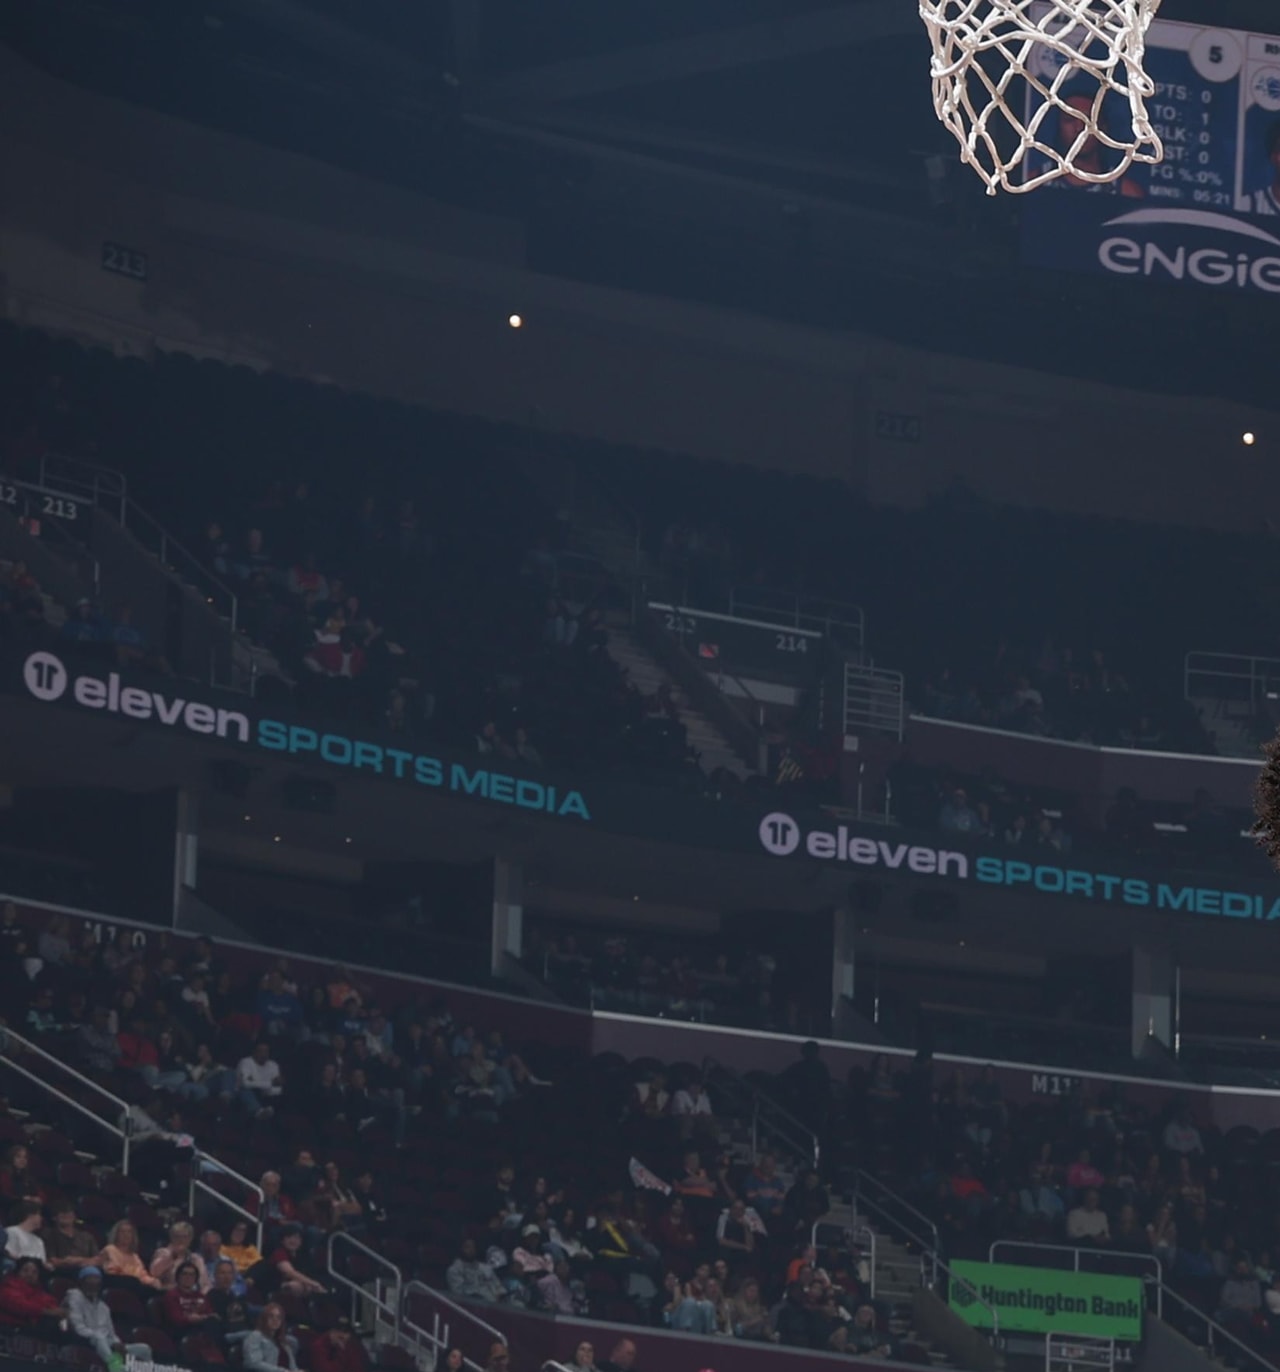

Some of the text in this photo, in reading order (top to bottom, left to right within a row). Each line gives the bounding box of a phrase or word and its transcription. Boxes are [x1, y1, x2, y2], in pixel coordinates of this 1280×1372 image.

[1208, 46, 1223, 63] 5
[1201, 91, 1211, 104] 0
[1154, 104, 1209, 125] TO: 1
[1200, 131, 1210, 145] 0
[1198, 151, 1209, 164] 0
[1193, 188, 1230, 205] 05:21
[42, 495, 78, 520] 213
[775, 633, 808, 654] 214
[74, 672, 591, 820] eleven SPORTS MEDIA
[807, 826, 967, 878] eleven
[976, 857, 1149, 903] SPORTS
[981, 1284, 1139, 1319] Huntington Bank
